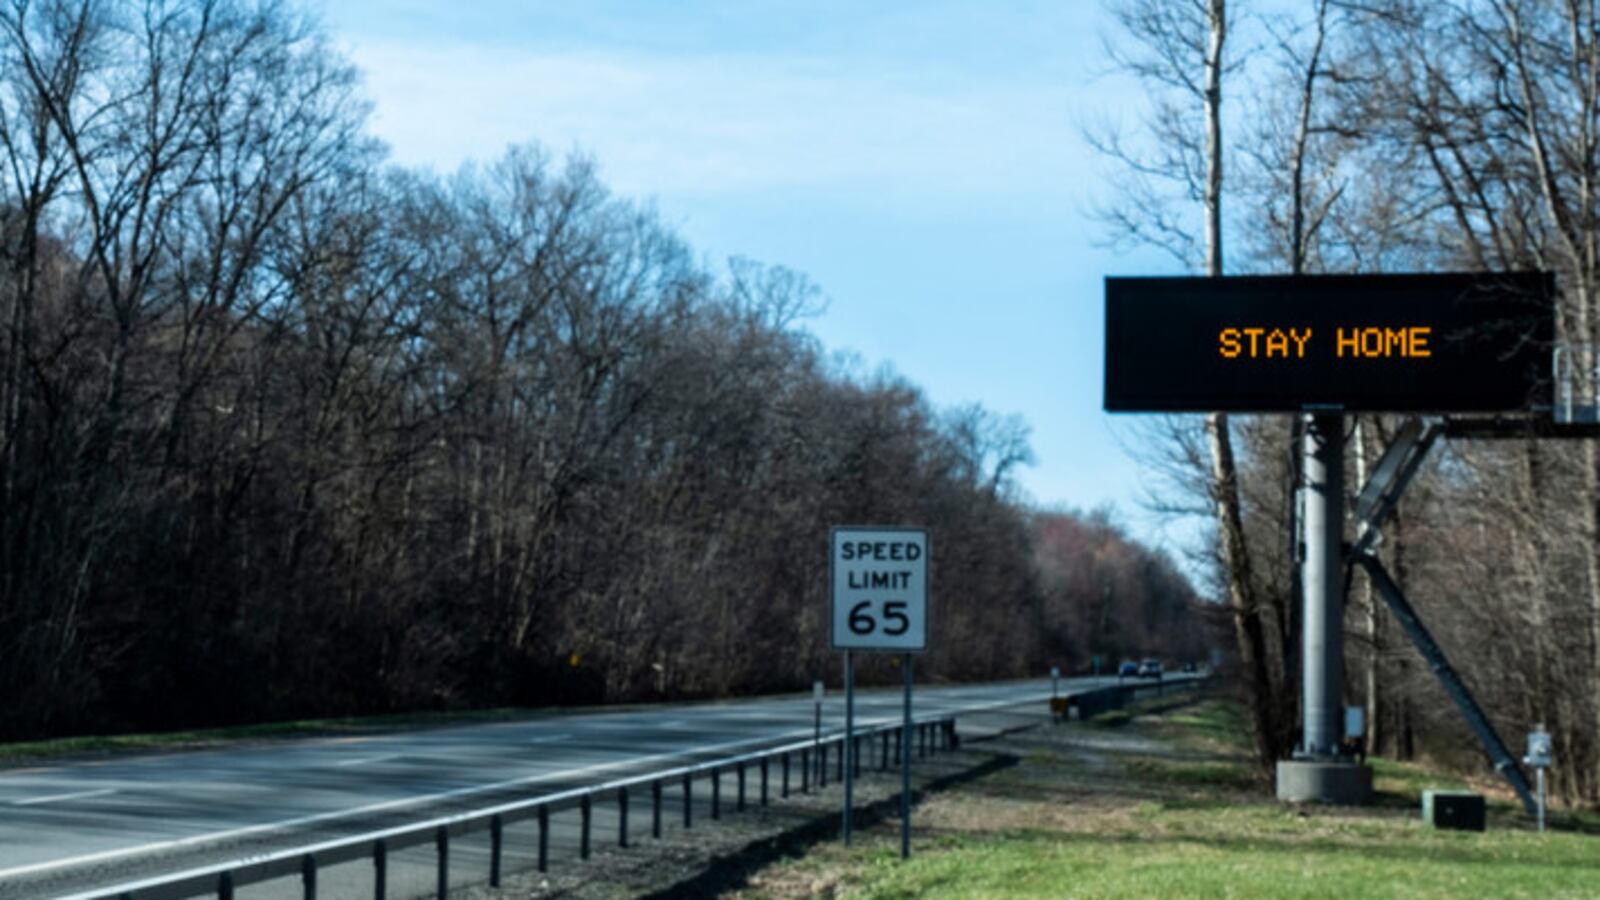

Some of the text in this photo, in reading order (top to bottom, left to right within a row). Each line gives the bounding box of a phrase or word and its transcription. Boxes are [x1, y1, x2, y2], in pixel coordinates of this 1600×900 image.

[1219, 327, 1431, 358] STAY HOME
[841, 541, 922, 562] SPEED
[848, 570, 912, 590] LIMIT
[847, 600, 910, 636] 65
